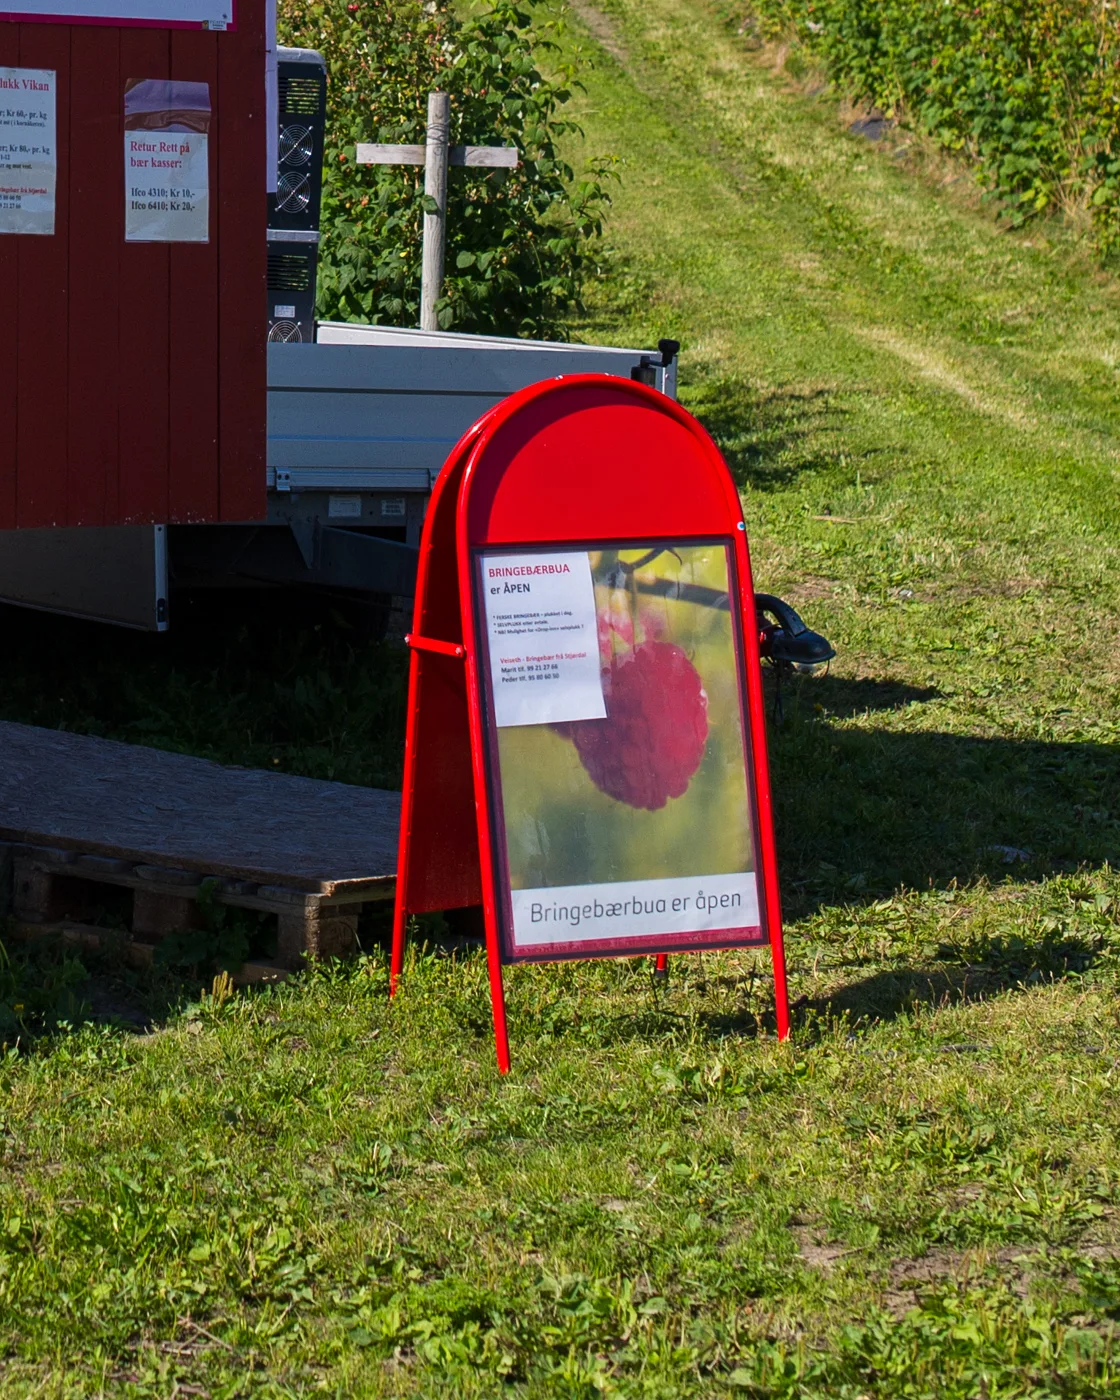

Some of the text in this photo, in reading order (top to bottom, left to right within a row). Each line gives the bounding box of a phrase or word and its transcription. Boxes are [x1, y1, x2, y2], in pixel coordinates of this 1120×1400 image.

[22, 79, 49, 91] Vikan
[7, 109, 15, 117] Kr
[39, 111, 48, 120] kg
[32, 147, 41, 155] pr.
[42, 146, 50, 155] kg
[130, 141, 190, 155] Retur Rett på
[130, 157, 182, 168] bær kasser:
[131, 188, 195, 199] Ifco 4310; Kr 10,-
[131, 201, 195, 212] Ifco 6410; Kr 20,-
[489, 564, 570, 578] BRINGEBÆRBUA
[490, 582, 530, 595] er ÅPEN
[531, 891, 741, 926] Bringebærbua er åpen
